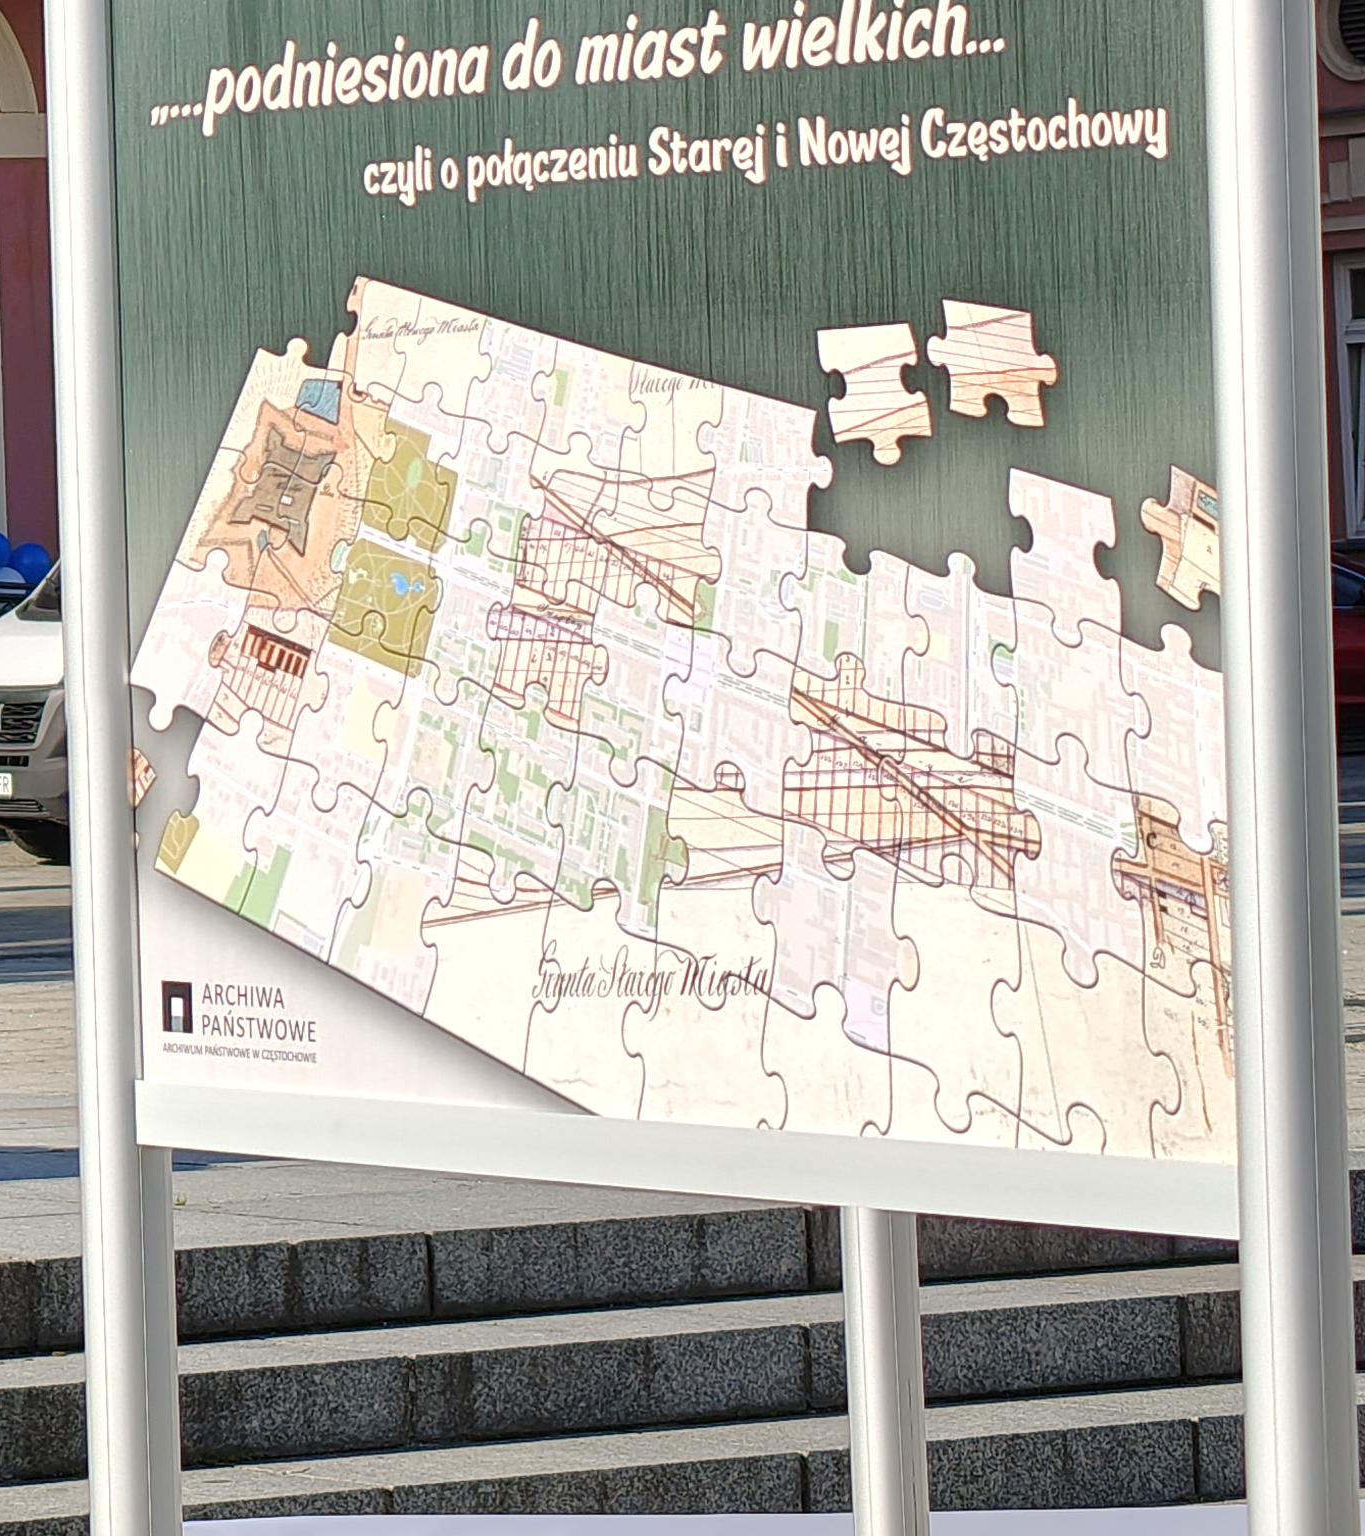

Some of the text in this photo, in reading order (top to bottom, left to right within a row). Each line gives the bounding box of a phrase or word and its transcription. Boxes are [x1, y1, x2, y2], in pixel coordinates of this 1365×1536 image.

[503, 17, 562, 91] do
[576, 9, 727, 85] miast
[363, 97, 1168, 207] czyli o połączeniu Starej i Nowej Częstochowy
[201, 982, 286, 1010] ARCHIWA
[201, 1009, 317, 1043] PAŃSTWOWE
[162, 1042, 318, 1064] ARCHIWUM PAŃSTWOWE W CZĘSTOCHOWIE
